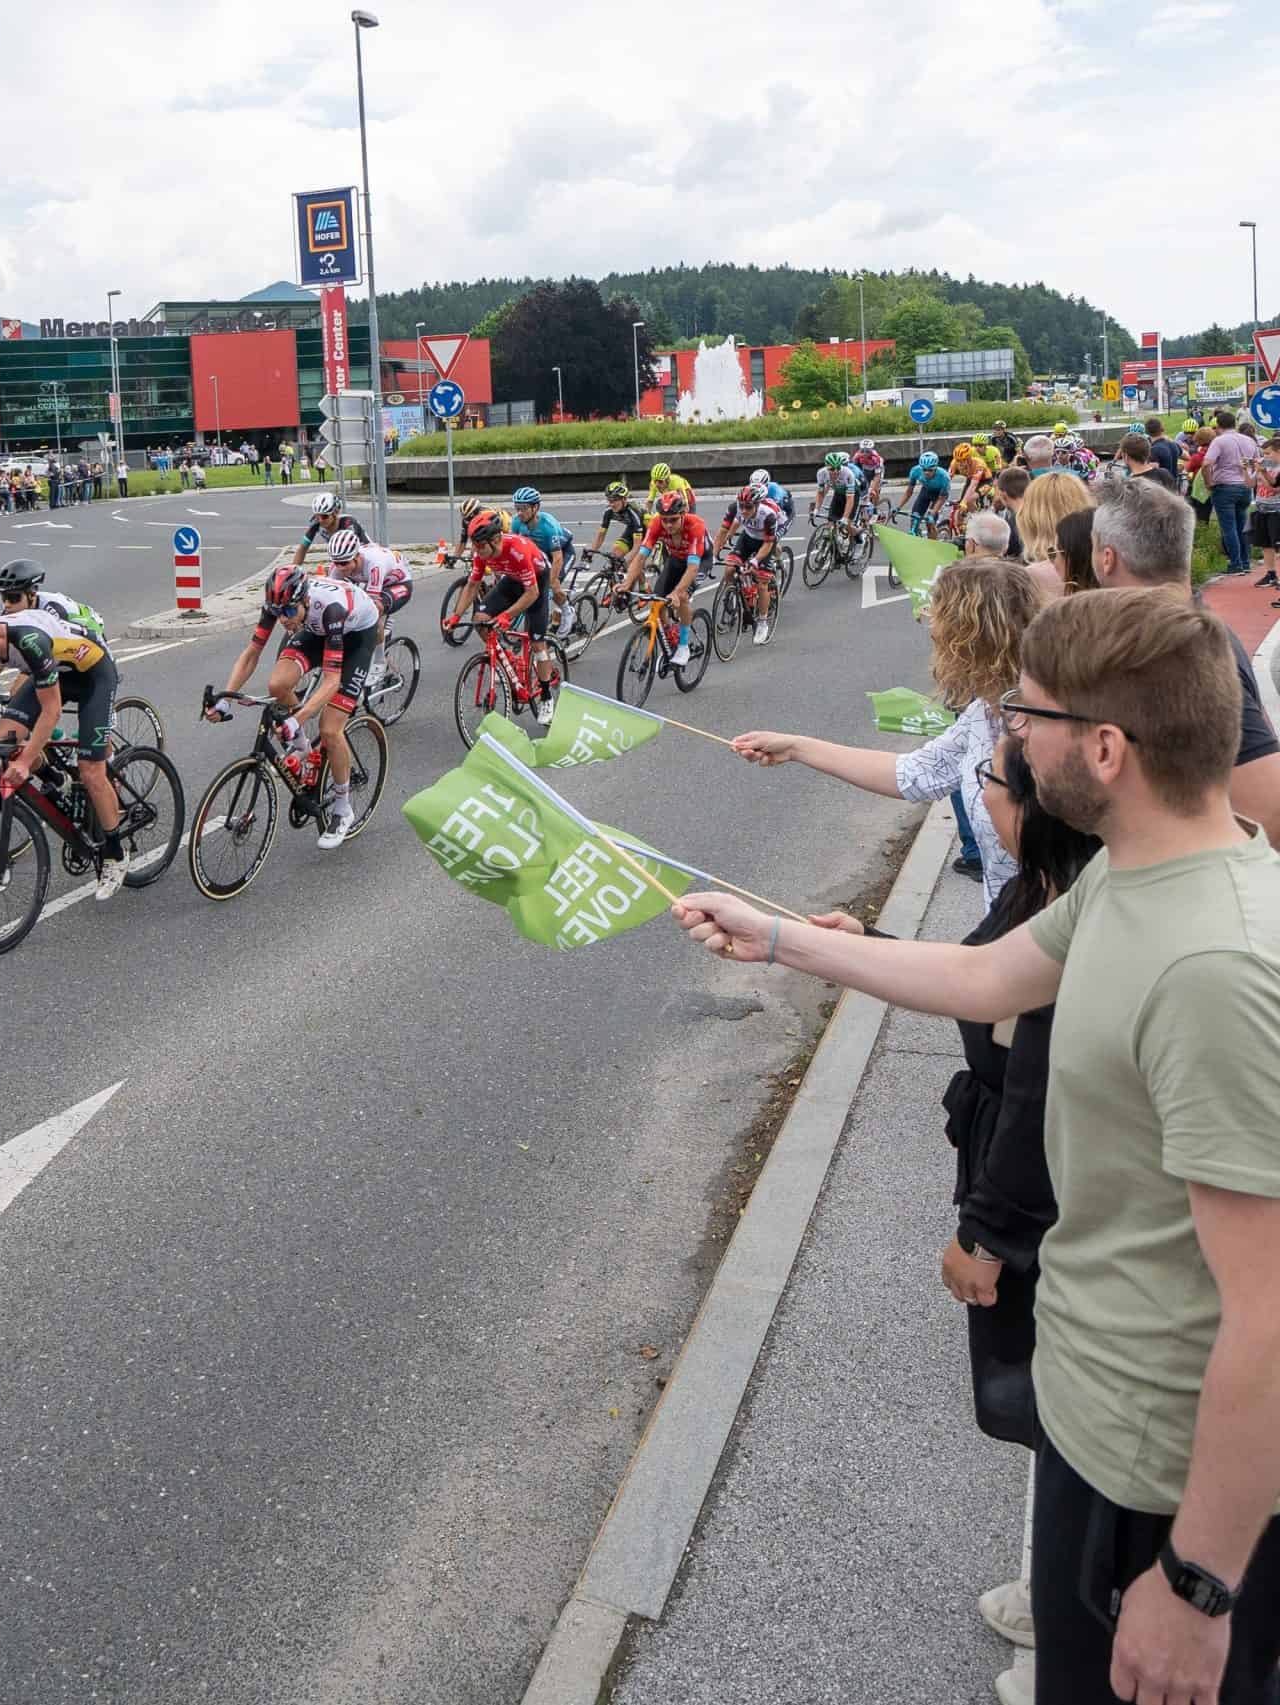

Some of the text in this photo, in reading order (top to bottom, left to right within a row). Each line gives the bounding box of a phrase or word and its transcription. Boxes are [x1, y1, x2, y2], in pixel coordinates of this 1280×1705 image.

[315, 231, 340, 241] HOFER
[39, 317, 167, 338] Mercator
[332, 309, 345, 361] Center
[347, 667, 368, 695] UAE
